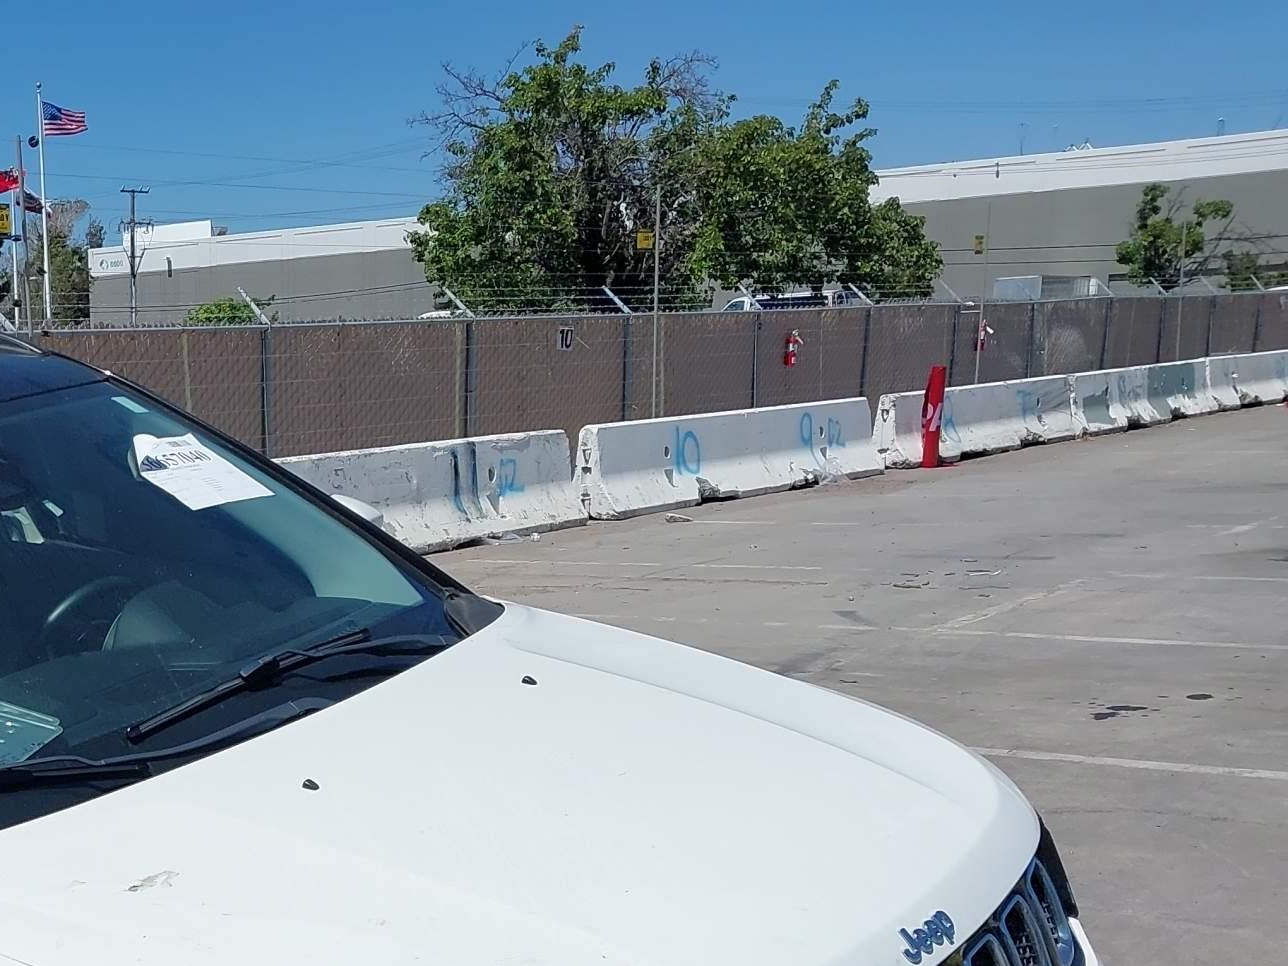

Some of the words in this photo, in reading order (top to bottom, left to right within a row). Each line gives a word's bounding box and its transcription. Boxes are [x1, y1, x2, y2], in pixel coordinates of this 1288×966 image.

[559, 328, 573, 349] 10
[674, 425, 701, 475] 10
[899, 910, 955, 965] Jeep
